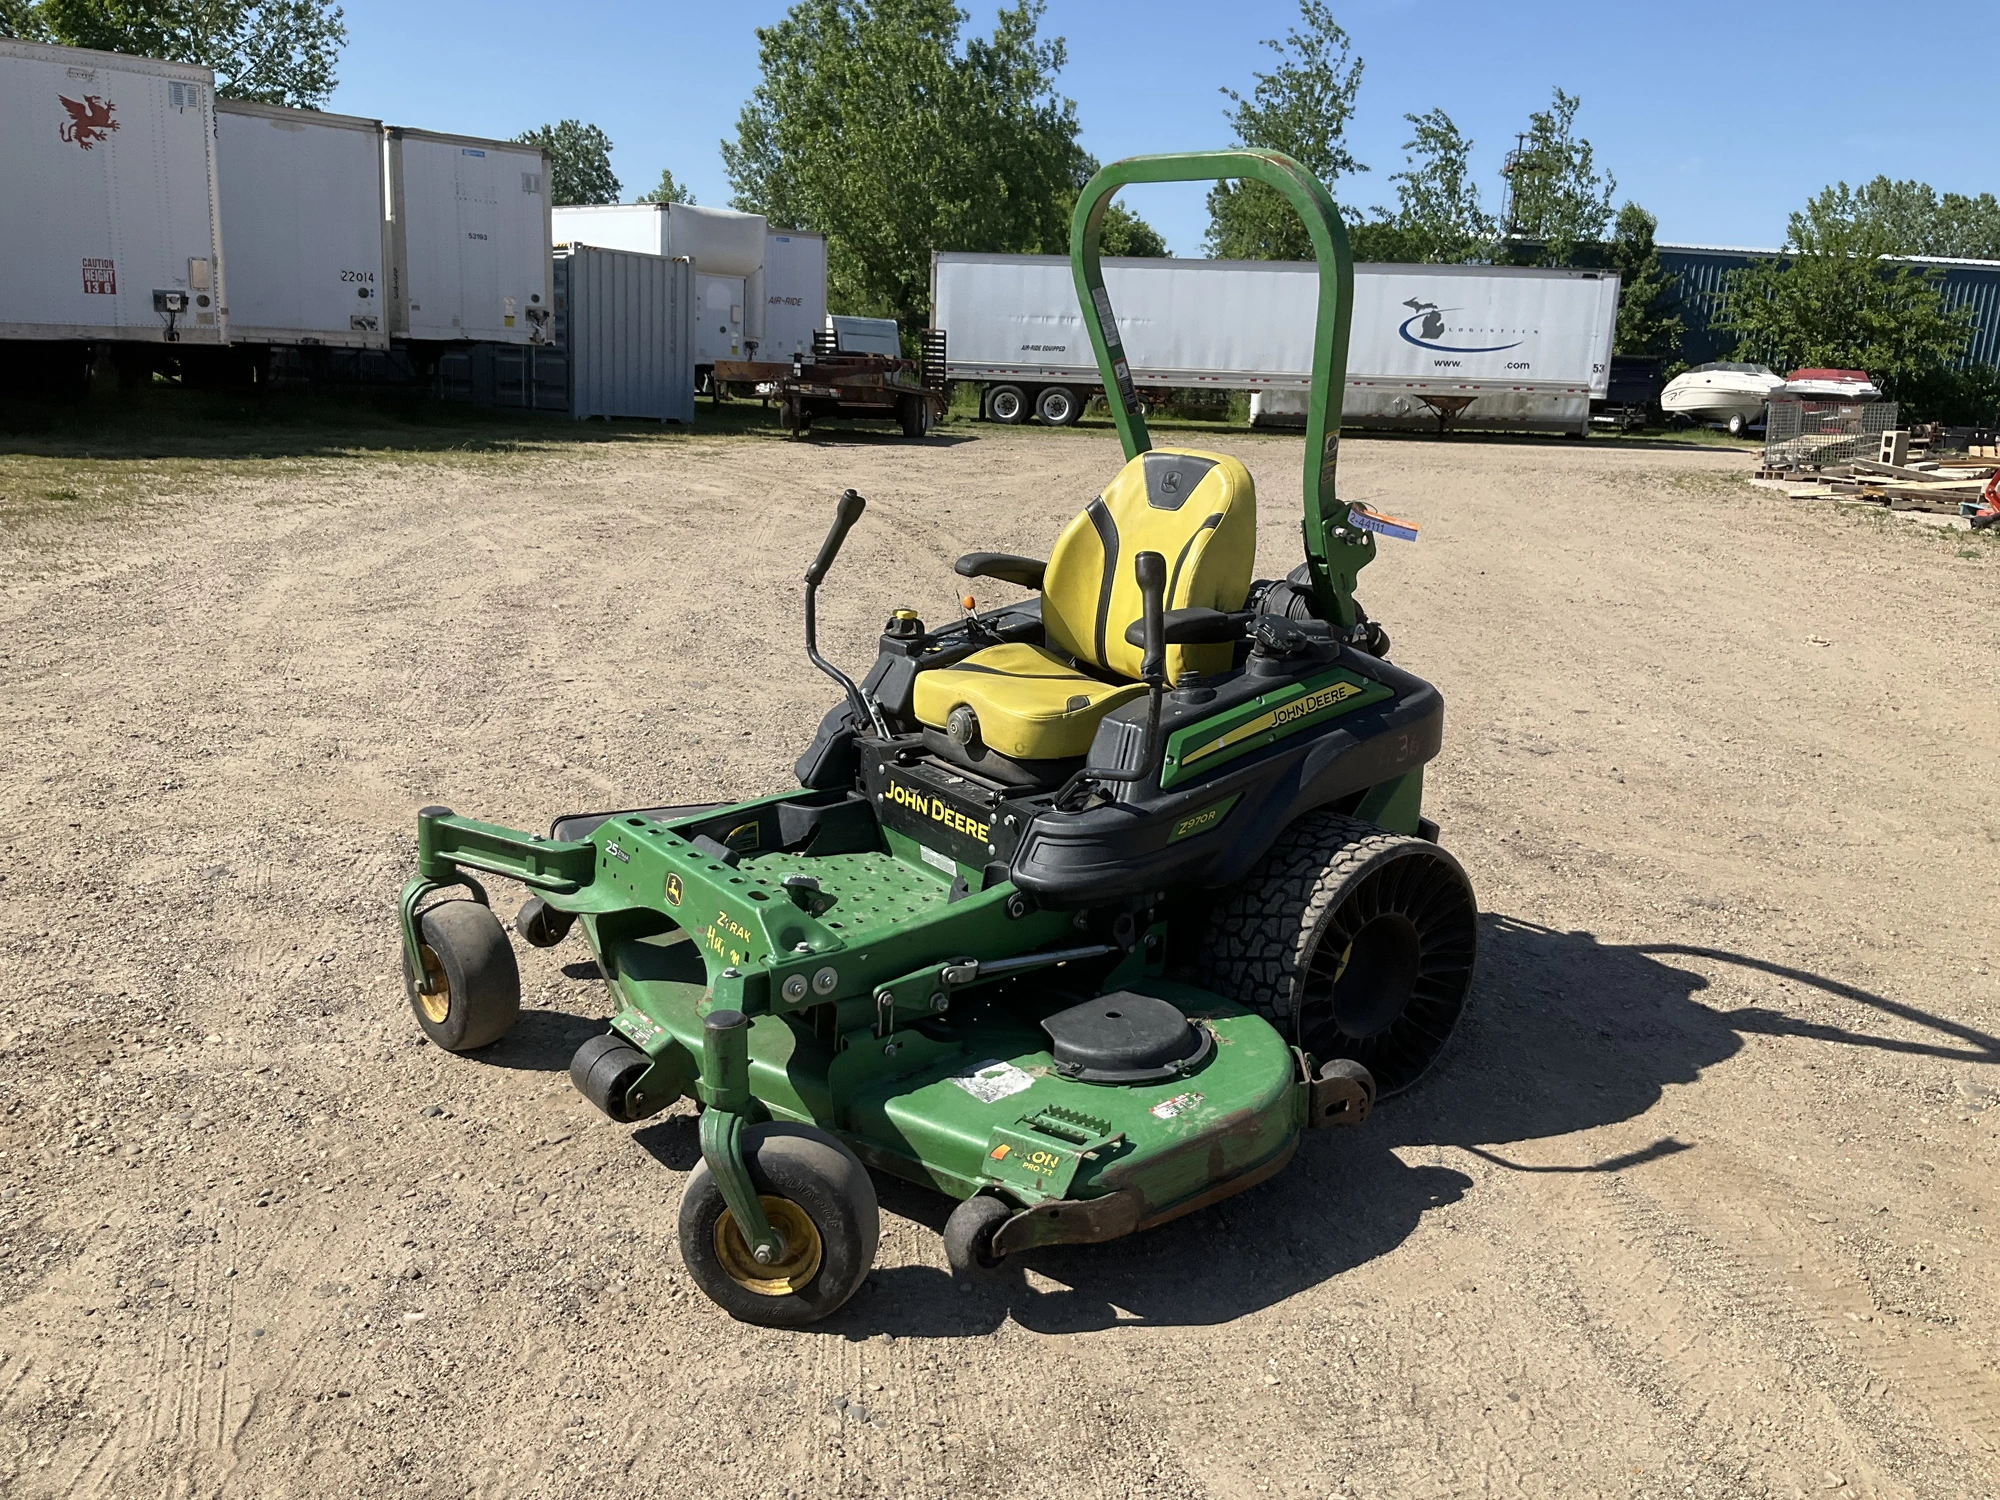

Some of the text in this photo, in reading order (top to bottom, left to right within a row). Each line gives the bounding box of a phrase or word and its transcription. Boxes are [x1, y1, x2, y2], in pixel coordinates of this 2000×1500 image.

[82, 258, 114, 268] CAUTION
[84, 269, 114, 282] HEIGHT
[341, 270, 374, 283] 22014
[768, 296, 803, 306] AIR-RIDE
[1448, 327, 1539, 335] LOGISTICS
[1021, 344, 1041, 352] AIR-RIDE
[1593, 363, 1605, 373] 53
[1348, 512, 1385, 534] 2-44111
[1271, 686, 1347, 727] JOHN DEERE
[885, 780, 990, 843] JOHN DEERE
[1178, 810, 1216, 835] Z970R
[606, 839, 619, 856] 25
[1022, 1161, 1040, 1172] PRO
